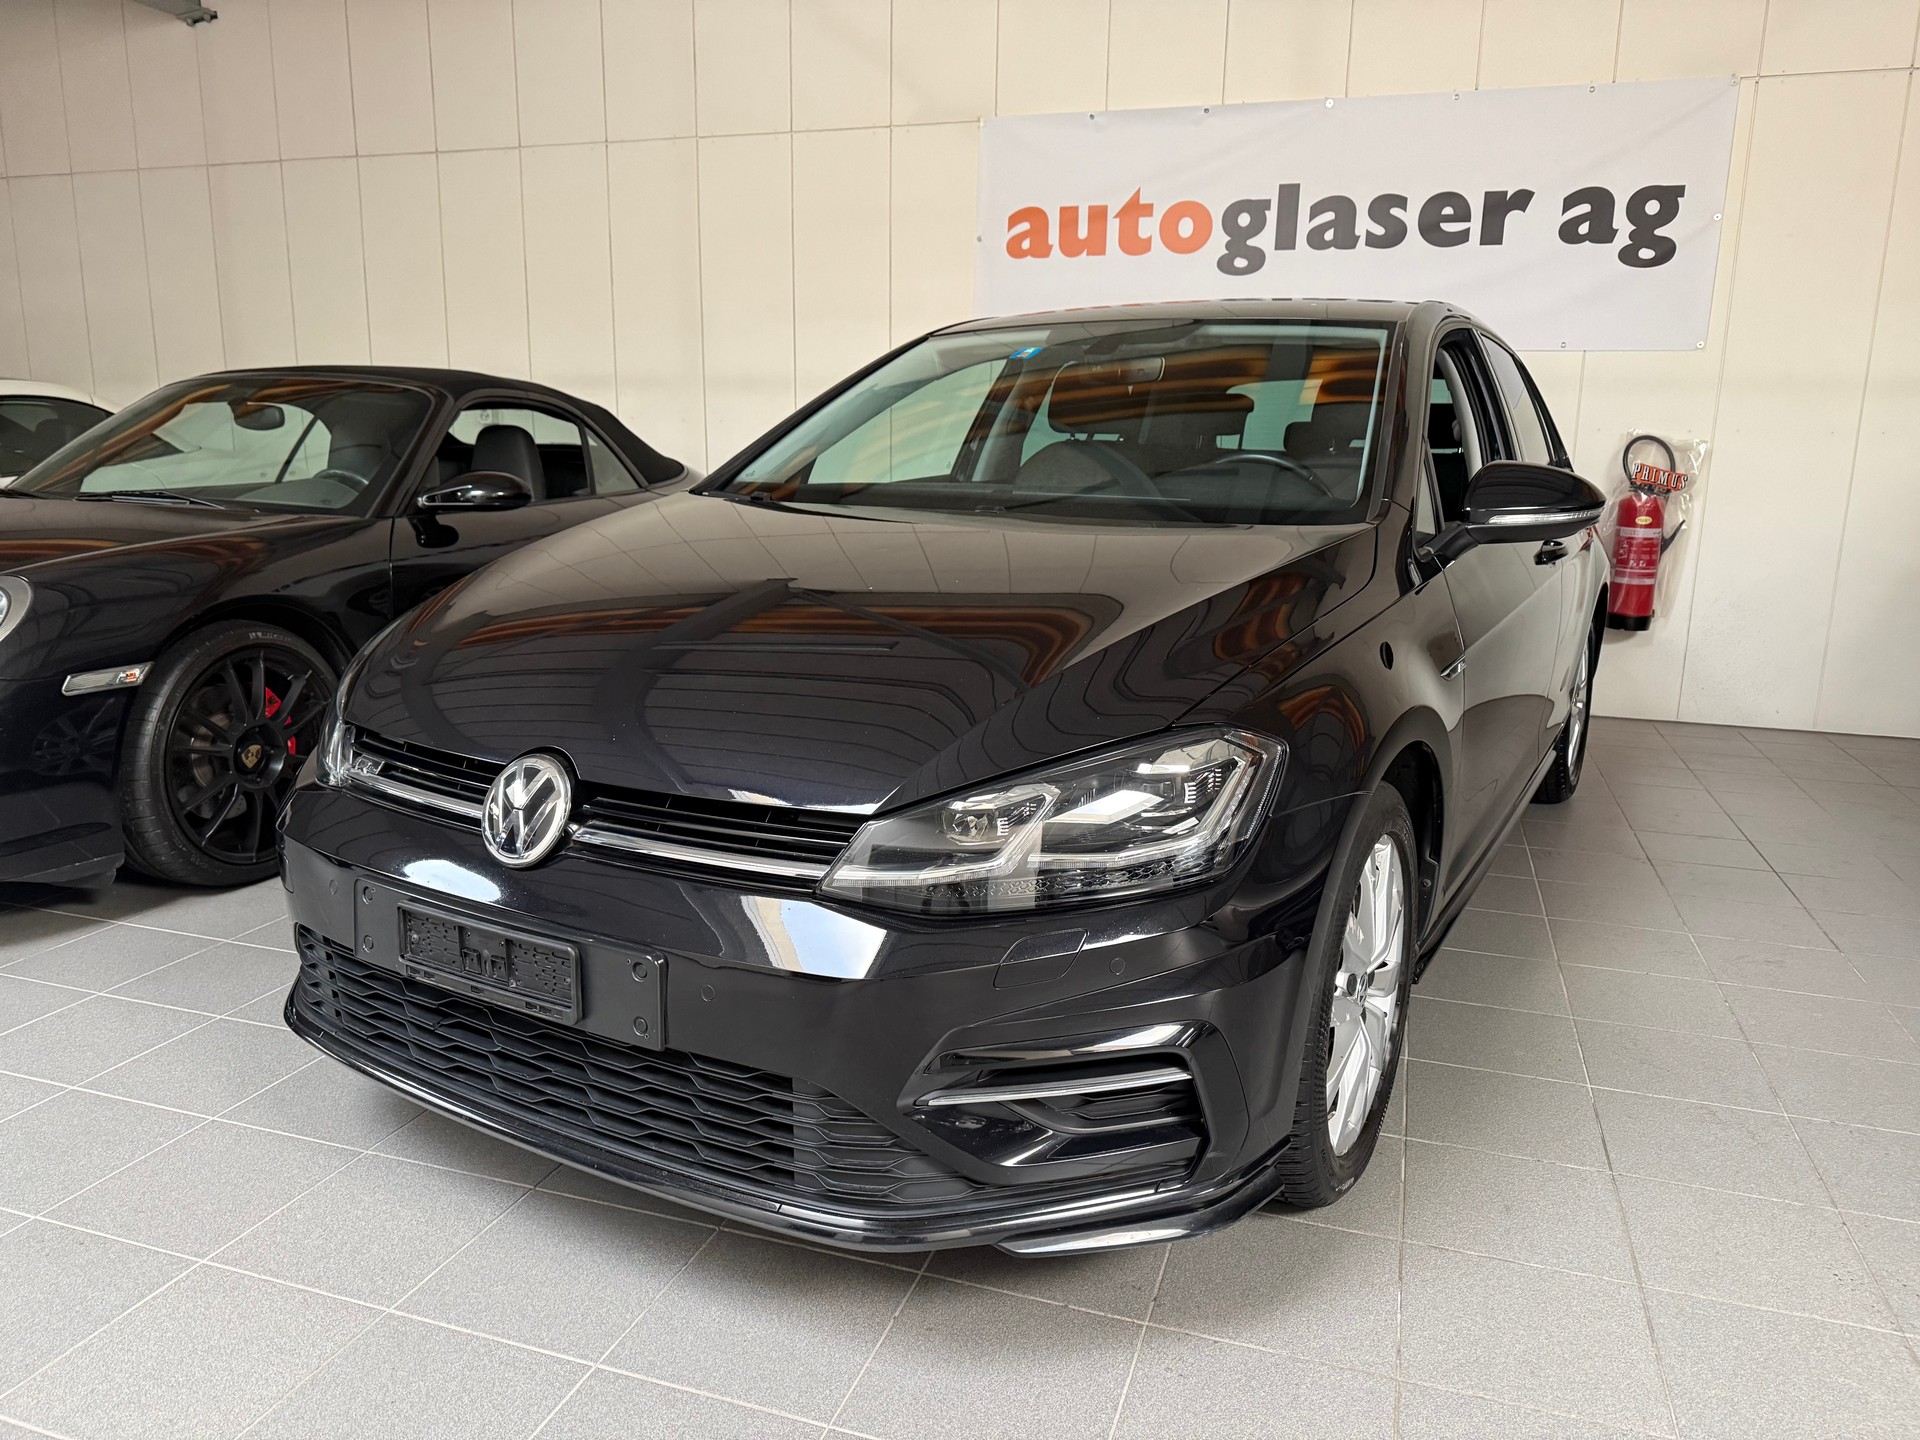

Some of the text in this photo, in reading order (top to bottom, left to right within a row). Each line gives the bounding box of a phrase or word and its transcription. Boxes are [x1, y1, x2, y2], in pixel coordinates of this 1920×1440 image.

[1005, 183, 1686, 276] autoglaser ag
[1631, 462, 1688, 490] PRIMUS
